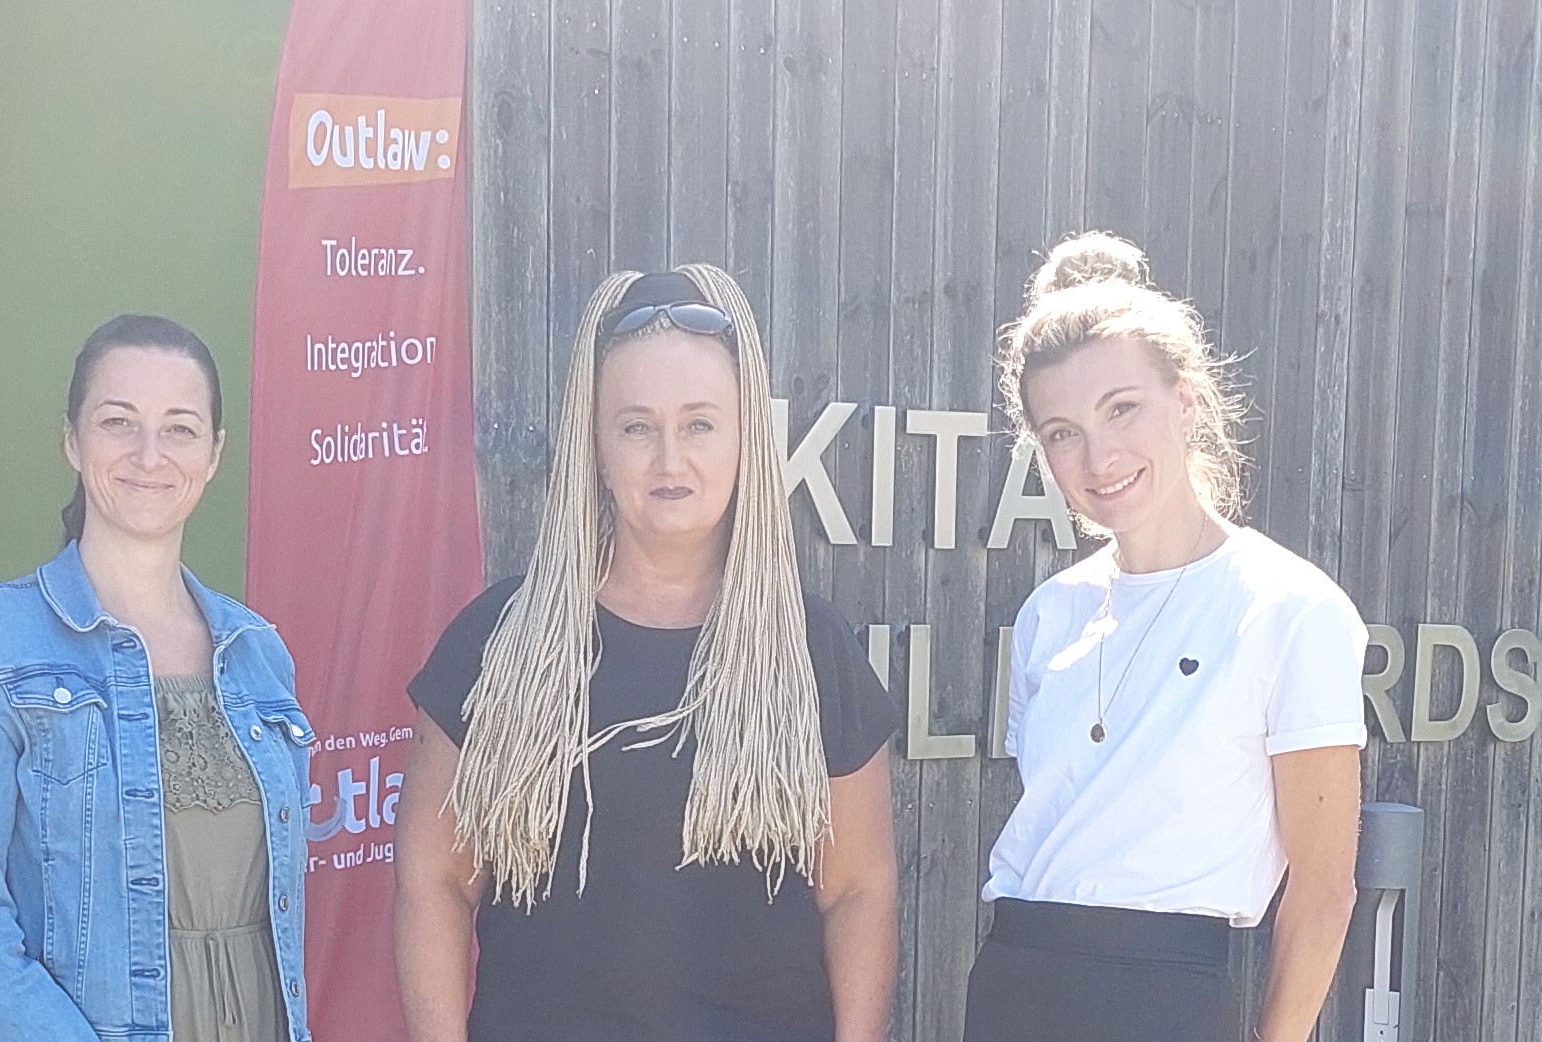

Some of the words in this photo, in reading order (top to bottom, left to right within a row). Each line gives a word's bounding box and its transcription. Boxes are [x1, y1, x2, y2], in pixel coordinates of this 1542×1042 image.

[307, 109, 451, 171] Outlaw:
[321, 236, 426, 277] Toleranz.
[771, 398, 1078, 550] KITA
[325, 735, 356, 751] den
[390, 726, 414, 742] Gem
[333, 843, 364, 870] und
[366, 842, 394, 863] Jug
